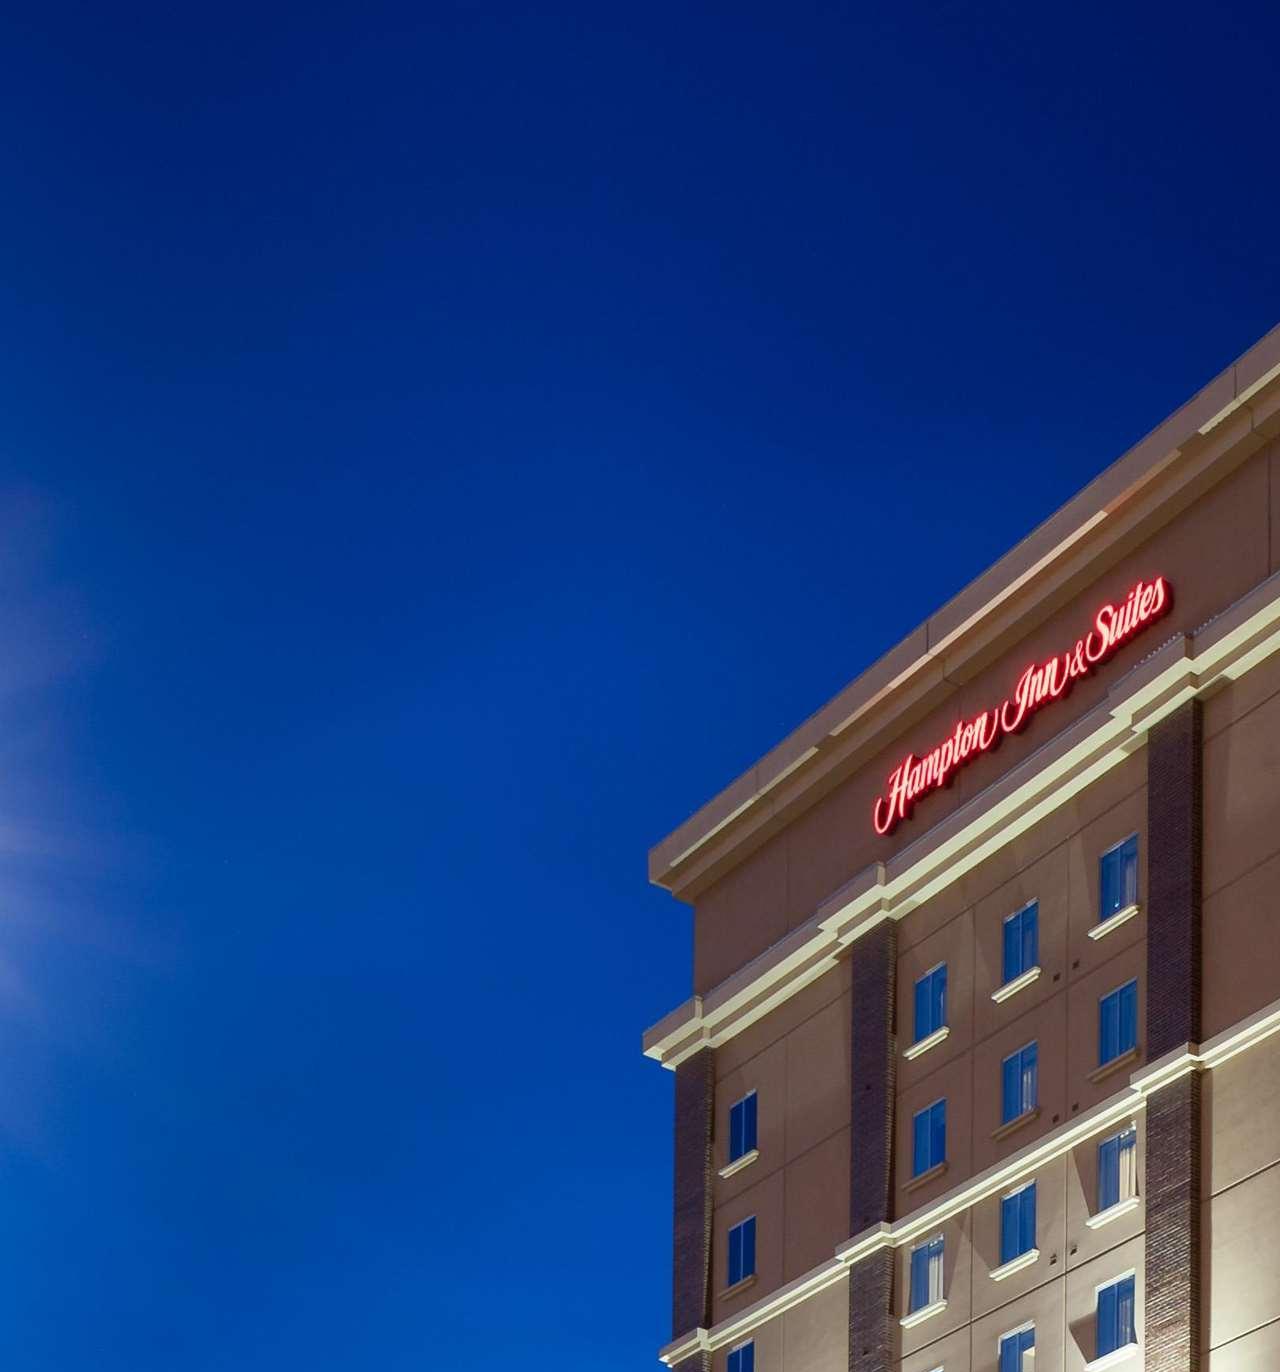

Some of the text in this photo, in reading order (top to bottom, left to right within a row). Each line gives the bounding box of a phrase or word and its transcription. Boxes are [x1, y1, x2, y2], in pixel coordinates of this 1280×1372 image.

[874, 577, 1165, 834] Hampton Inn & Suites
